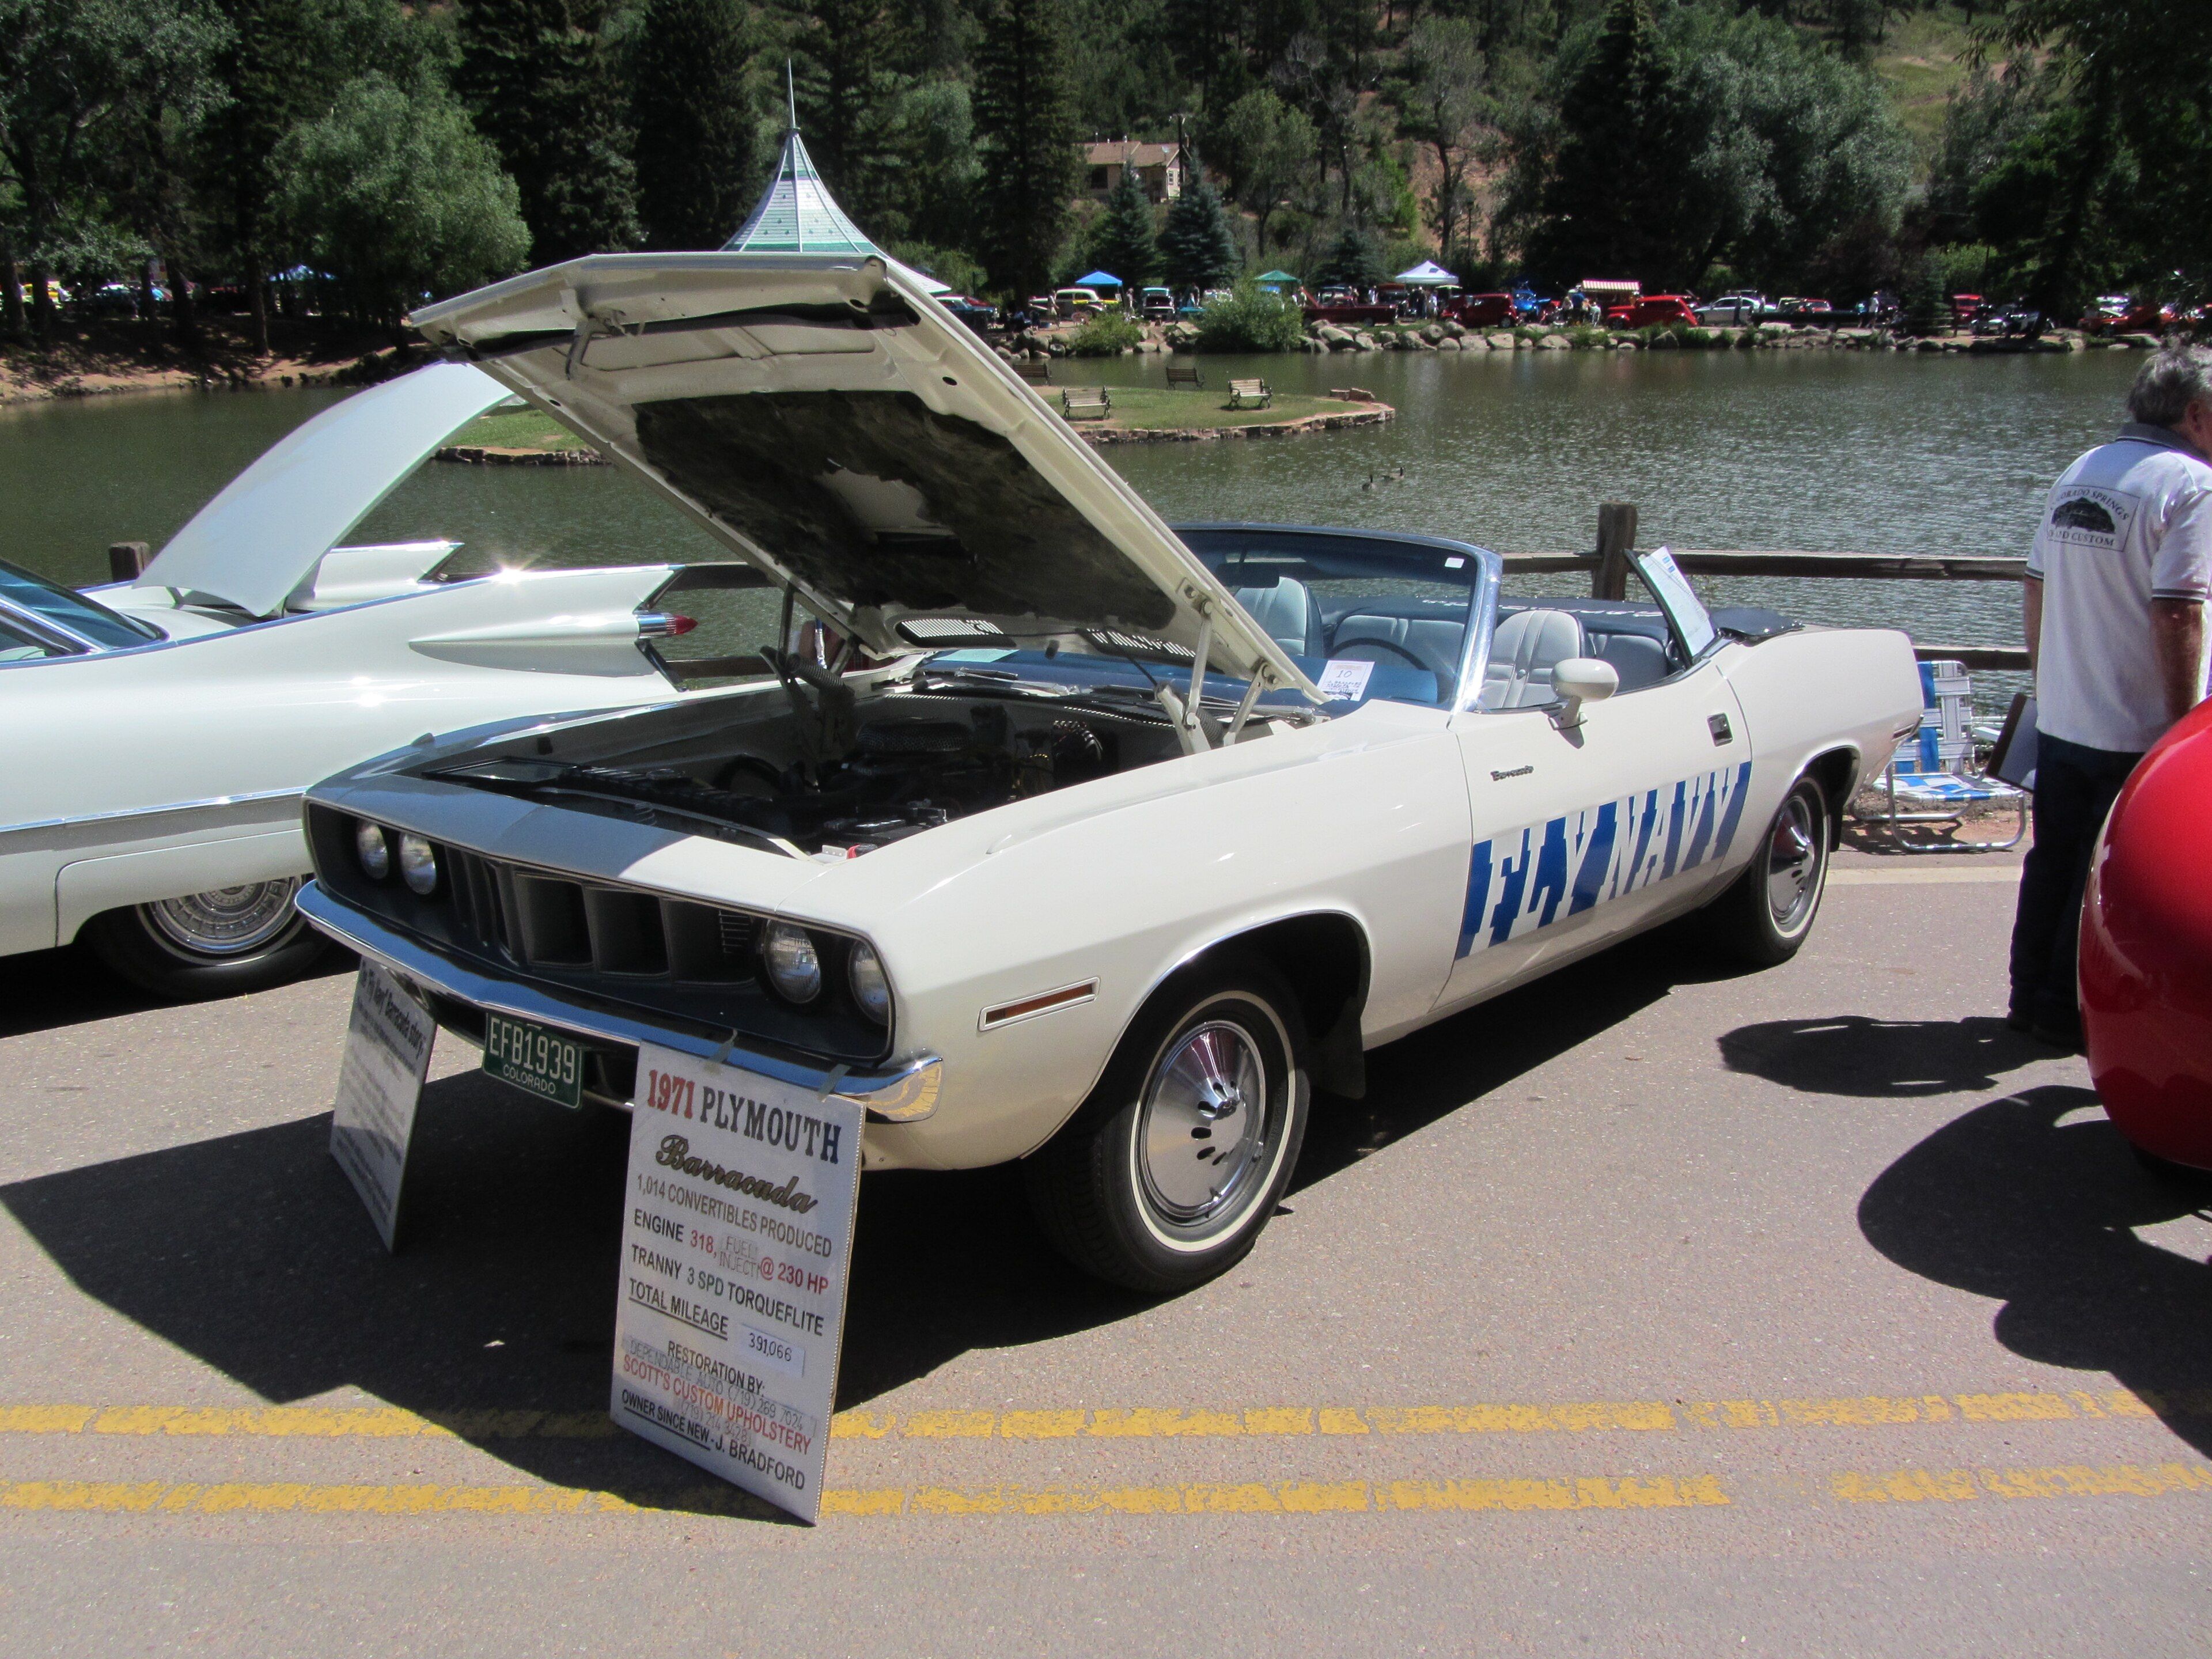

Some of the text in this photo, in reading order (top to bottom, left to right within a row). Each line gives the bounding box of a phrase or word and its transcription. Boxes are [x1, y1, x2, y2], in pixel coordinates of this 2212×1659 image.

[2072, 532, 2115, 546] CUSTOM
[2091, 491, 2129, 520] SPRINGS
[1468, 763, 1741, 957] FLY NAVY
[490, 1017, 575, 1085] EFB1939
[503, 1063, 556, 1094] COLORADO
[647, 1069, 842, 1165] 1971 PLYMOUTH
[656, 1134, 818, 1214] Barracuda
[634, 1208, 829, 1296] ENGINE 318, @ 230 HP
[637, 1173, 832, 1258] 1,014 CONVERTIBLES PRODUCED
[629, 1277, 729, 1335] TOTAL MILEAGE
[631, 1244, 824, 1336] TRANNY 3 SPD TORQUEFLITE
[630, 1339, 692, 1381] DEPENDABLE
[757, 1398, 777, 1419] 269
[779, 1407, 804, 1431] 7024
[668, 1340, 765, 1397] RESTORATION BY:
[749, 1332, 792, 1362] 391,066
[622, 1389, 656, 1418] OWNER
[657, 1406, 686, 1433] SINCE
[687, 1419, 710, 1442] NEW
[715, 1434, 725, 1453] J.
[729, 1439, 805, 1490] BRADFORD
[623, 1354, 812, 1456] SCOTT'S CUSTOM UPHOLSTERY
